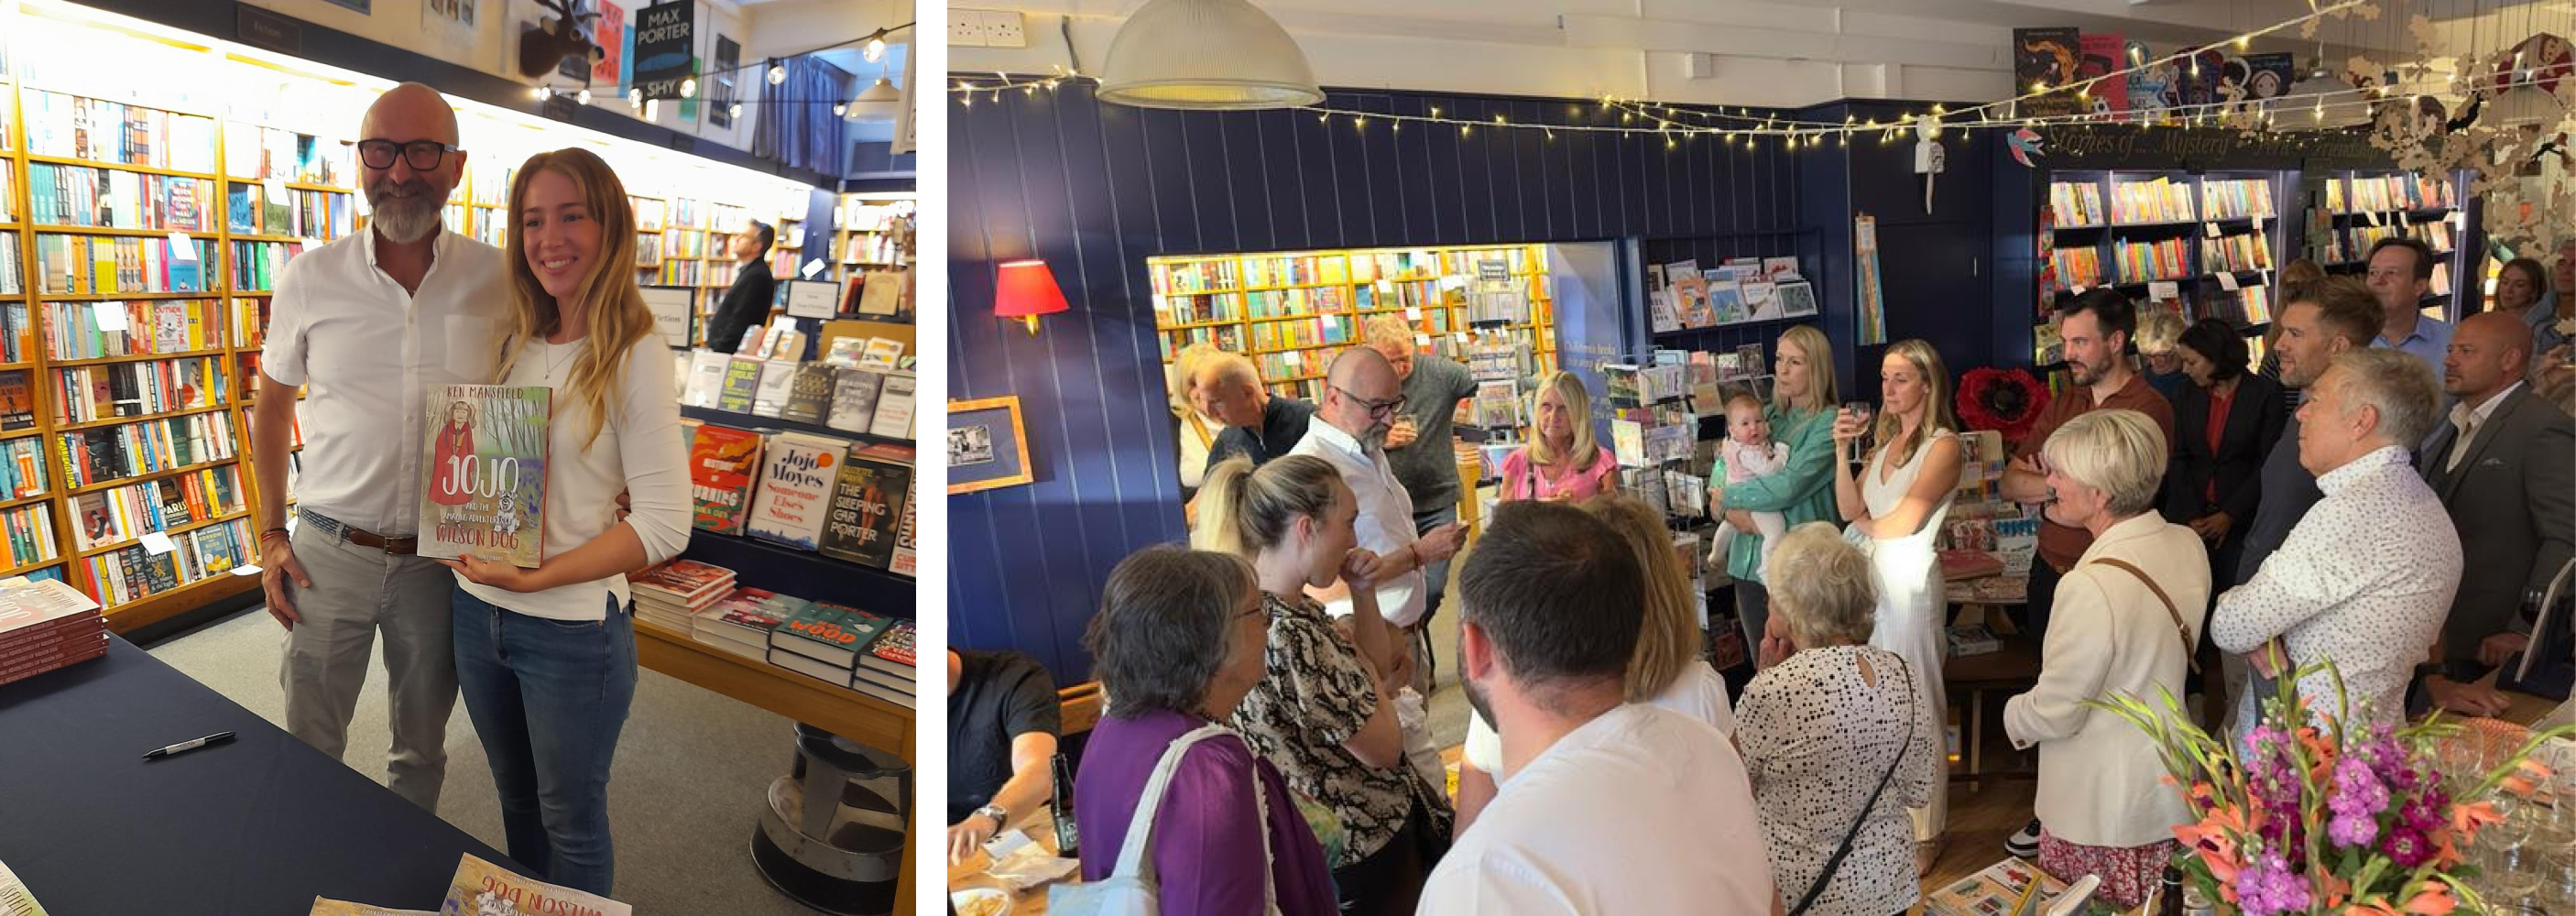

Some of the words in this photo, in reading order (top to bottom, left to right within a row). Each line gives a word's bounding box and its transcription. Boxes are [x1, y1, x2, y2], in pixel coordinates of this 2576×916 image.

[647, 8, 681, 27] MAX
[638, 22, 690, 45] PORTER
[647, 79, 678, 97] SHY
[447, 386, 464, 398] KEN
[469, 387, 524, 399] MANSFIELD
[703, 458, 736, 472] HISTORY
[781, 449, 820, 471] Jojo
[442, 454, 519, 498] JOJO
[770, 463, 824, 487] Moyes
[844, 465, 875, 477] SUZETTE
[693, 485, 738, 507] URNING
[766, 483, 820, 501] Someone
[839, 483, 861, 497] THE
[465, 502, 478, 511] AND
[479, 503, 489, 512] THE
[769, 507, 803, 523] Shoes
[835, 496, 886, 516] SLEEPING
[443, 512, 468, 522] AMAZING
[468, 514, 504, 525] ADVENTURES
[833, 508, 858, 524] CAR
[435, 525, 486, 547] WILSON
[490, 530, 519, 550] DOG
[829, 521, 879, 542] PORTER
[790, 620, 856, 643] WOOD
[482, 876, 521, 904] DOG
